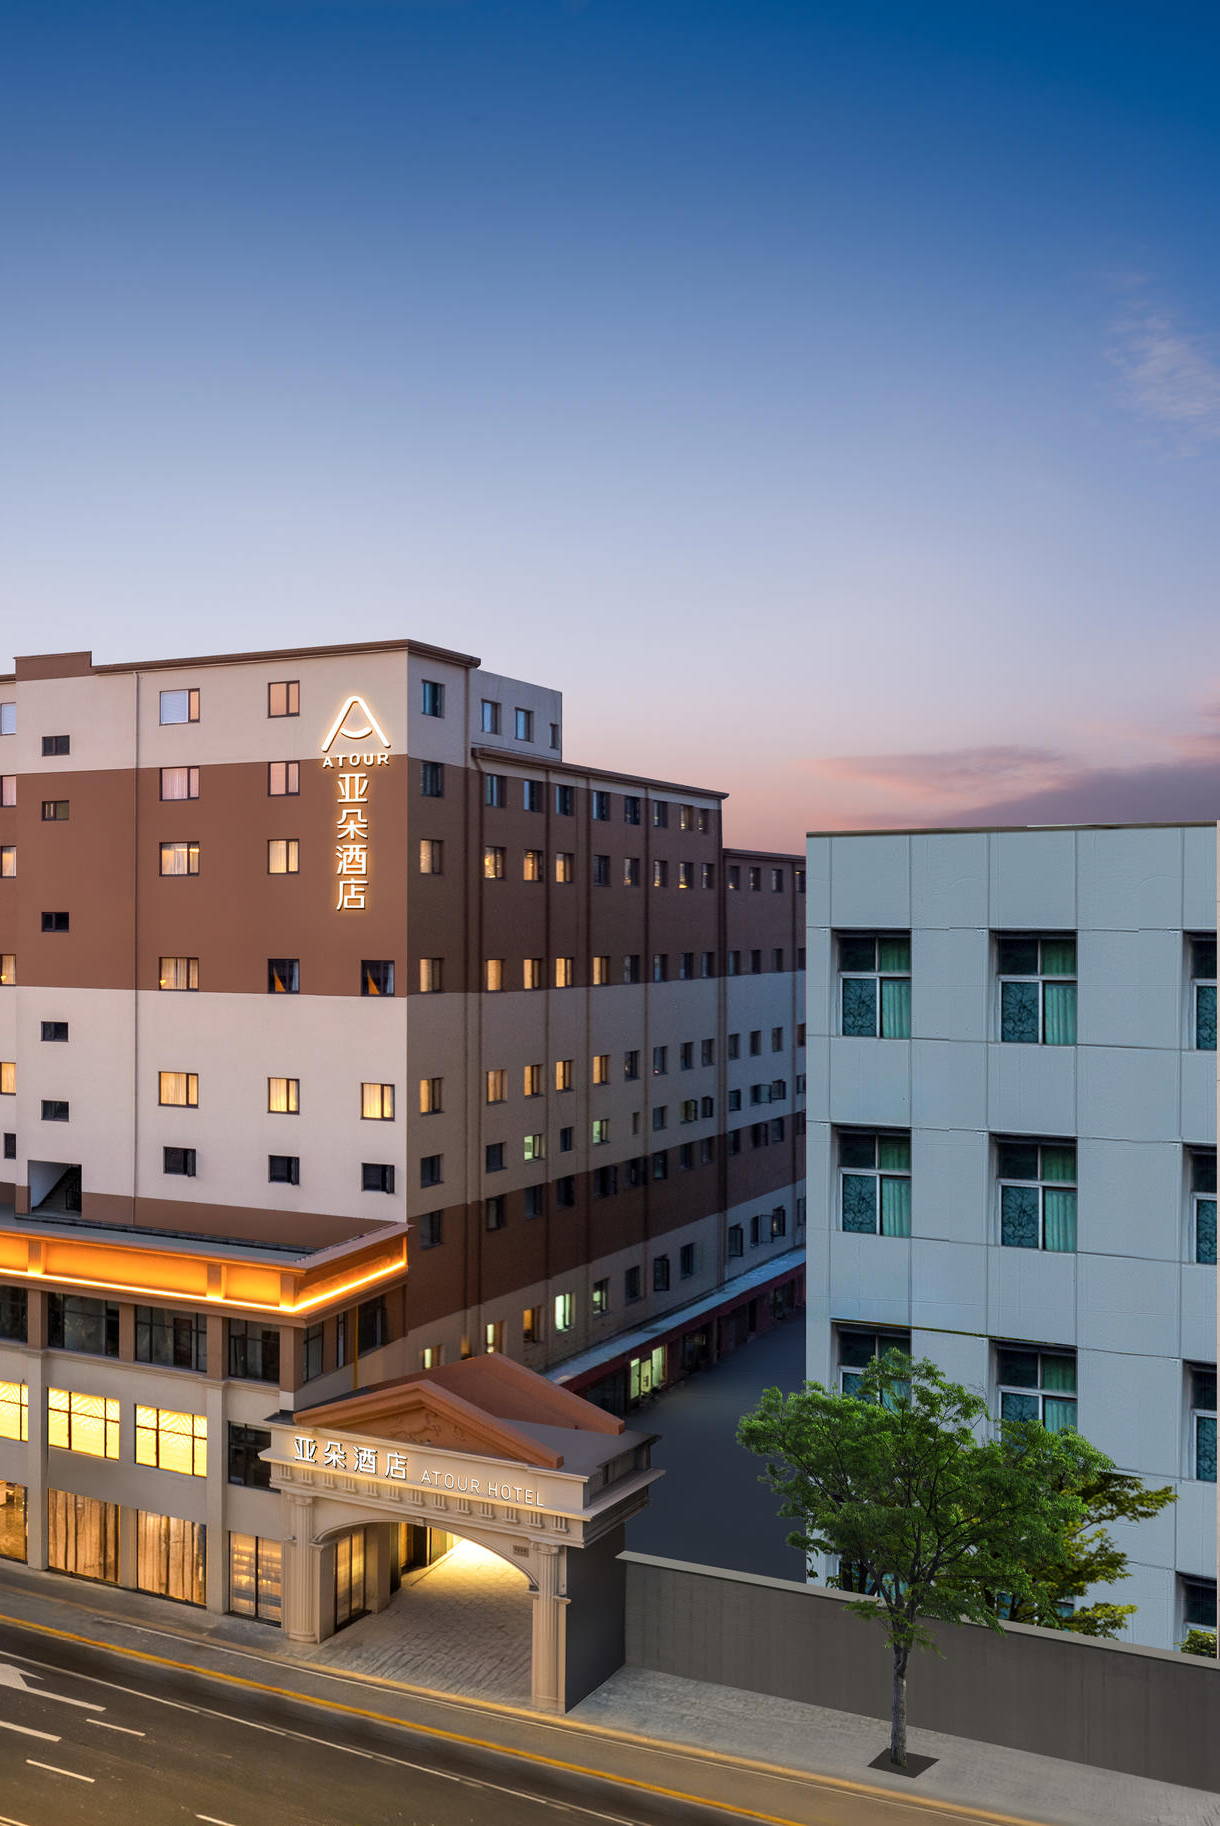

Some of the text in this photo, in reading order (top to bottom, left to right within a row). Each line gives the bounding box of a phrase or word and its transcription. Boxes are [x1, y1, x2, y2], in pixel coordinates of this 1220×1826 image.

[322, 752, 390, 768] ATOUR
[336, 772, 368, 911] 亚朵酒店
[293, 1436, 408, 1480] 亚朵酒店
[420, 1469, 545, 1507] ATOUR HOTEL
